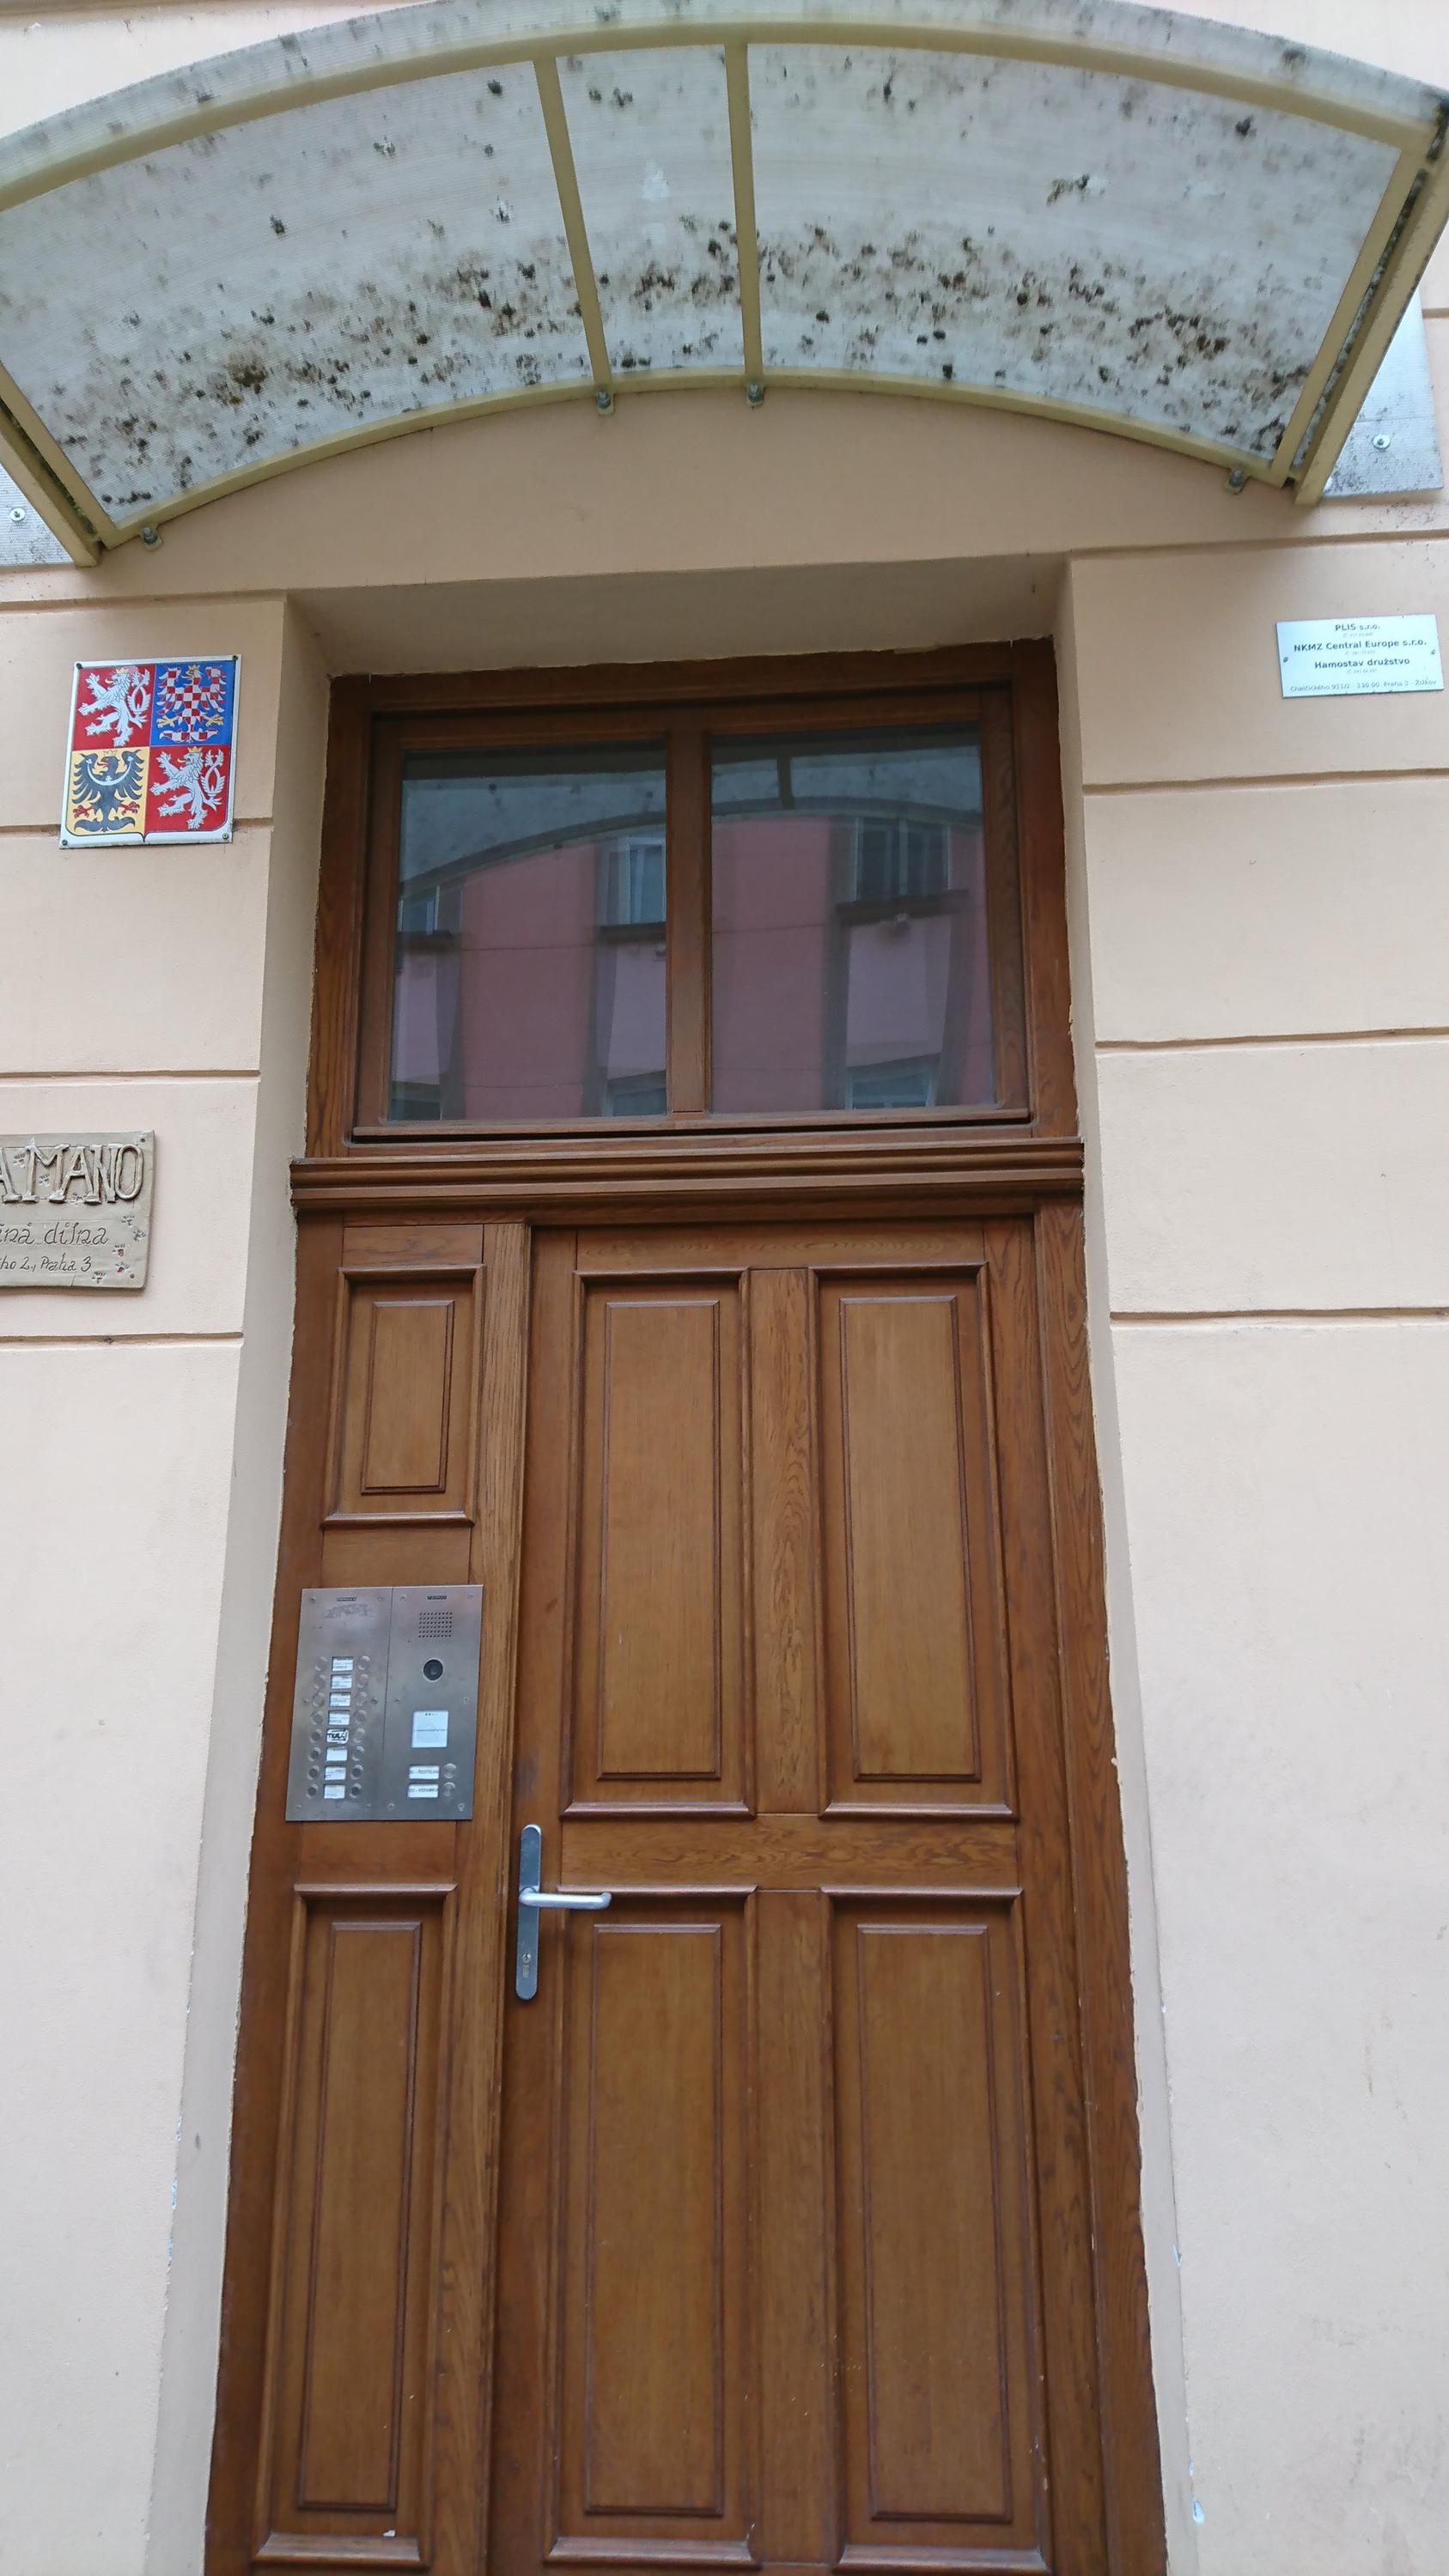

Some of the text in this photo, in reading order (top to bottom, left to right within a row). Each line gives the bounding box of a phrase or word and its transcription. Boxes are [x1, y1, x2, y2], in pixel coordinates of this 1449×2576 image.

[1335, 623, 1356, 632] PLIS
[1294, 638, 1427, 653] NKMZ Central Europe s.r.o.
[1315, 657, 1410, 670] Hamostav družstvo
[0, 1254, 17, 1270] ho
[40, 1253, 77, 1273] Praha
[81, 1255, 93, 1273] 3
